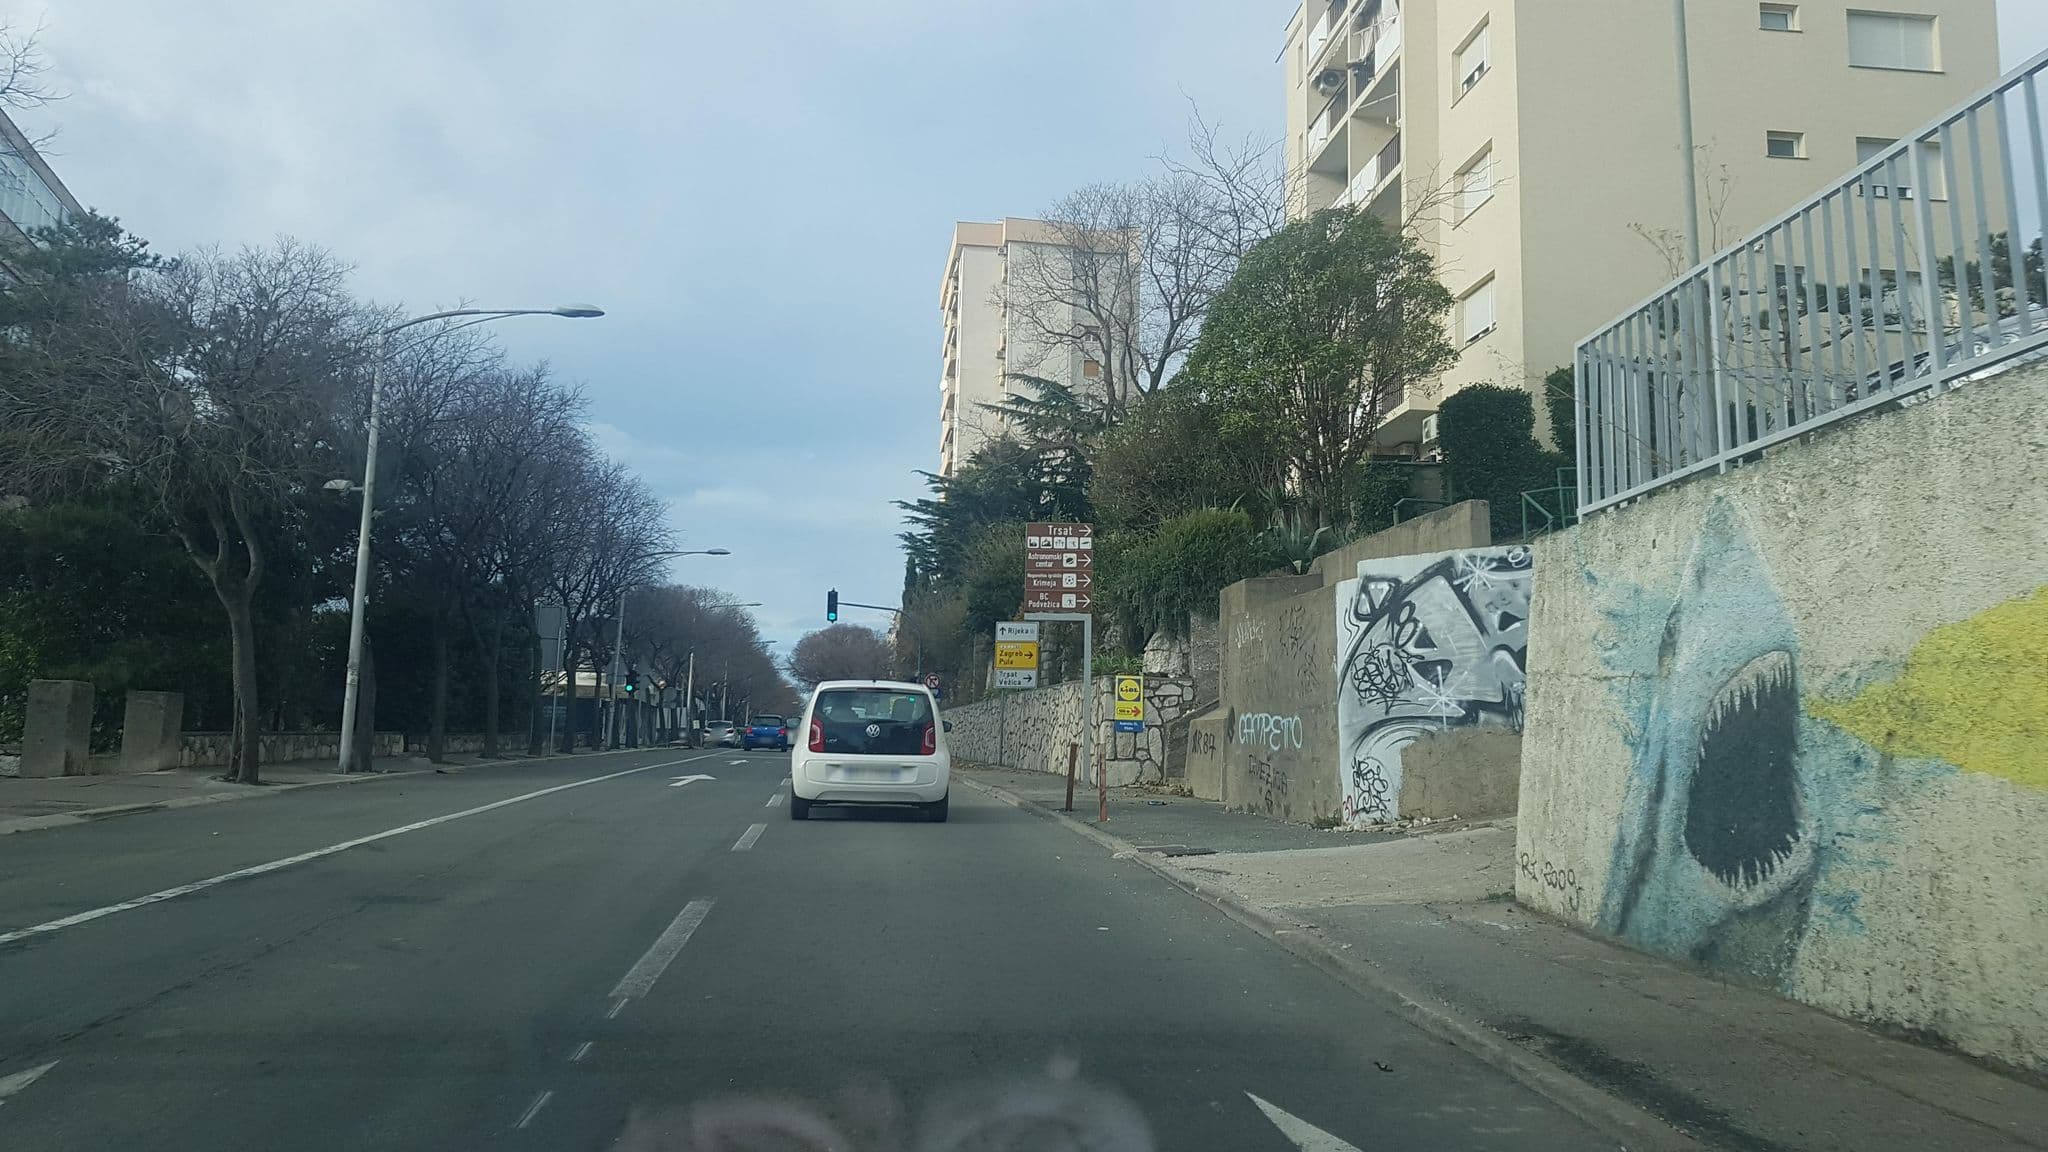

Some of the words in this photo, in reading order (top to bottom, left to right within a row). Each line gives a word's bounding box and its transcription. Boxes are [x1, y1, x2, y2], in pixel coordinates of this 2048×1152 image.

[1048, 525, 1073, 536] Trsat
[1028, 552, 1062, 560] Astronomski
[1035, 560, 1054, 568] centar
[1033, 579, 1057, 588] Krimeja
[1039, 592, 1049, 600] BC
[1028, 599, 1061, 608] Podvežica
[1007, 627, 1029, 635] Rijeka
[999, 650, 1024, 658] Zagreb
[998, 670, 1018, 678] Trsat
[998, 678, 1022, 686] Vežica
